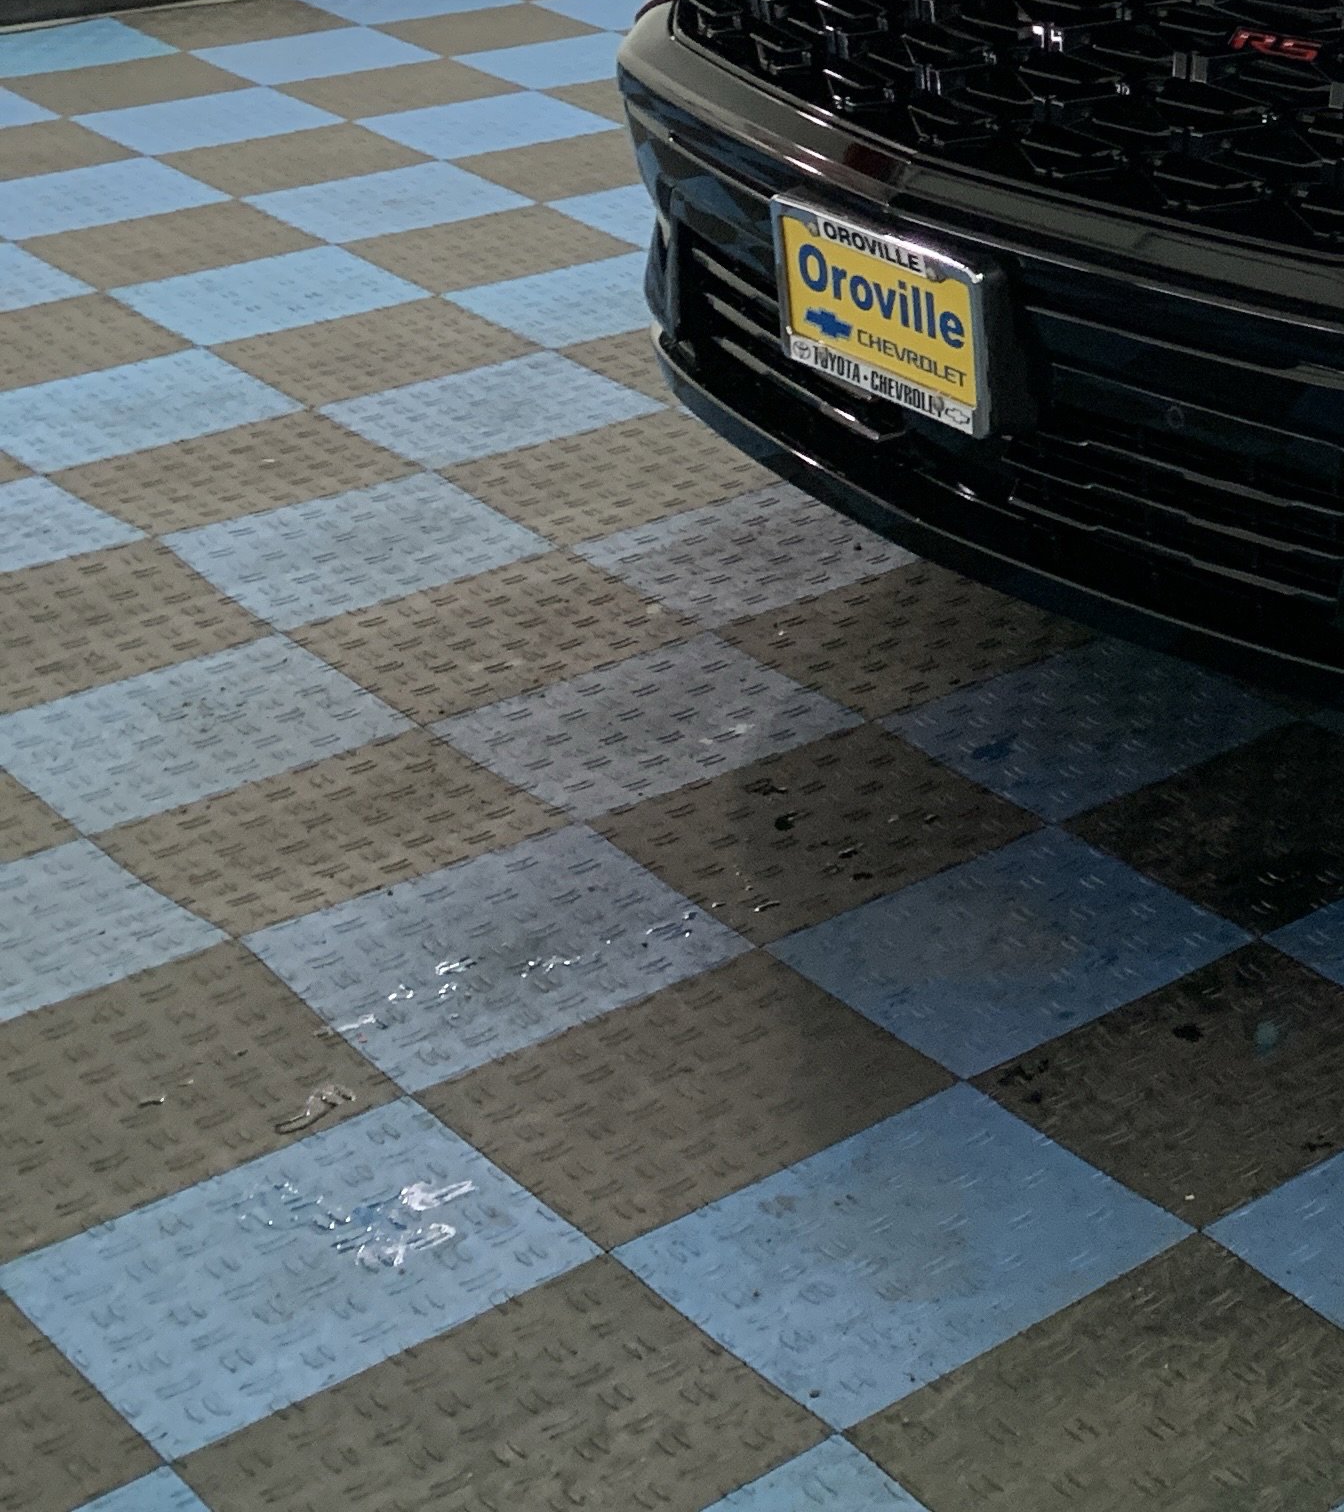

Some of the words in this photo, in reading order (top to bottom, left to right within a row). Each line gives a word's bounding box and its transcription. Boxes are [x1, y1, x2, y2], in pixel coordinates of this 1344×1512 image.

[1228, 26, 1322, 63] RS
[822, 221, 923, 273] OROVILLE
[798, 243, 966, 349] Oroville
[857, 328, 968, 388] CHEVROLET
